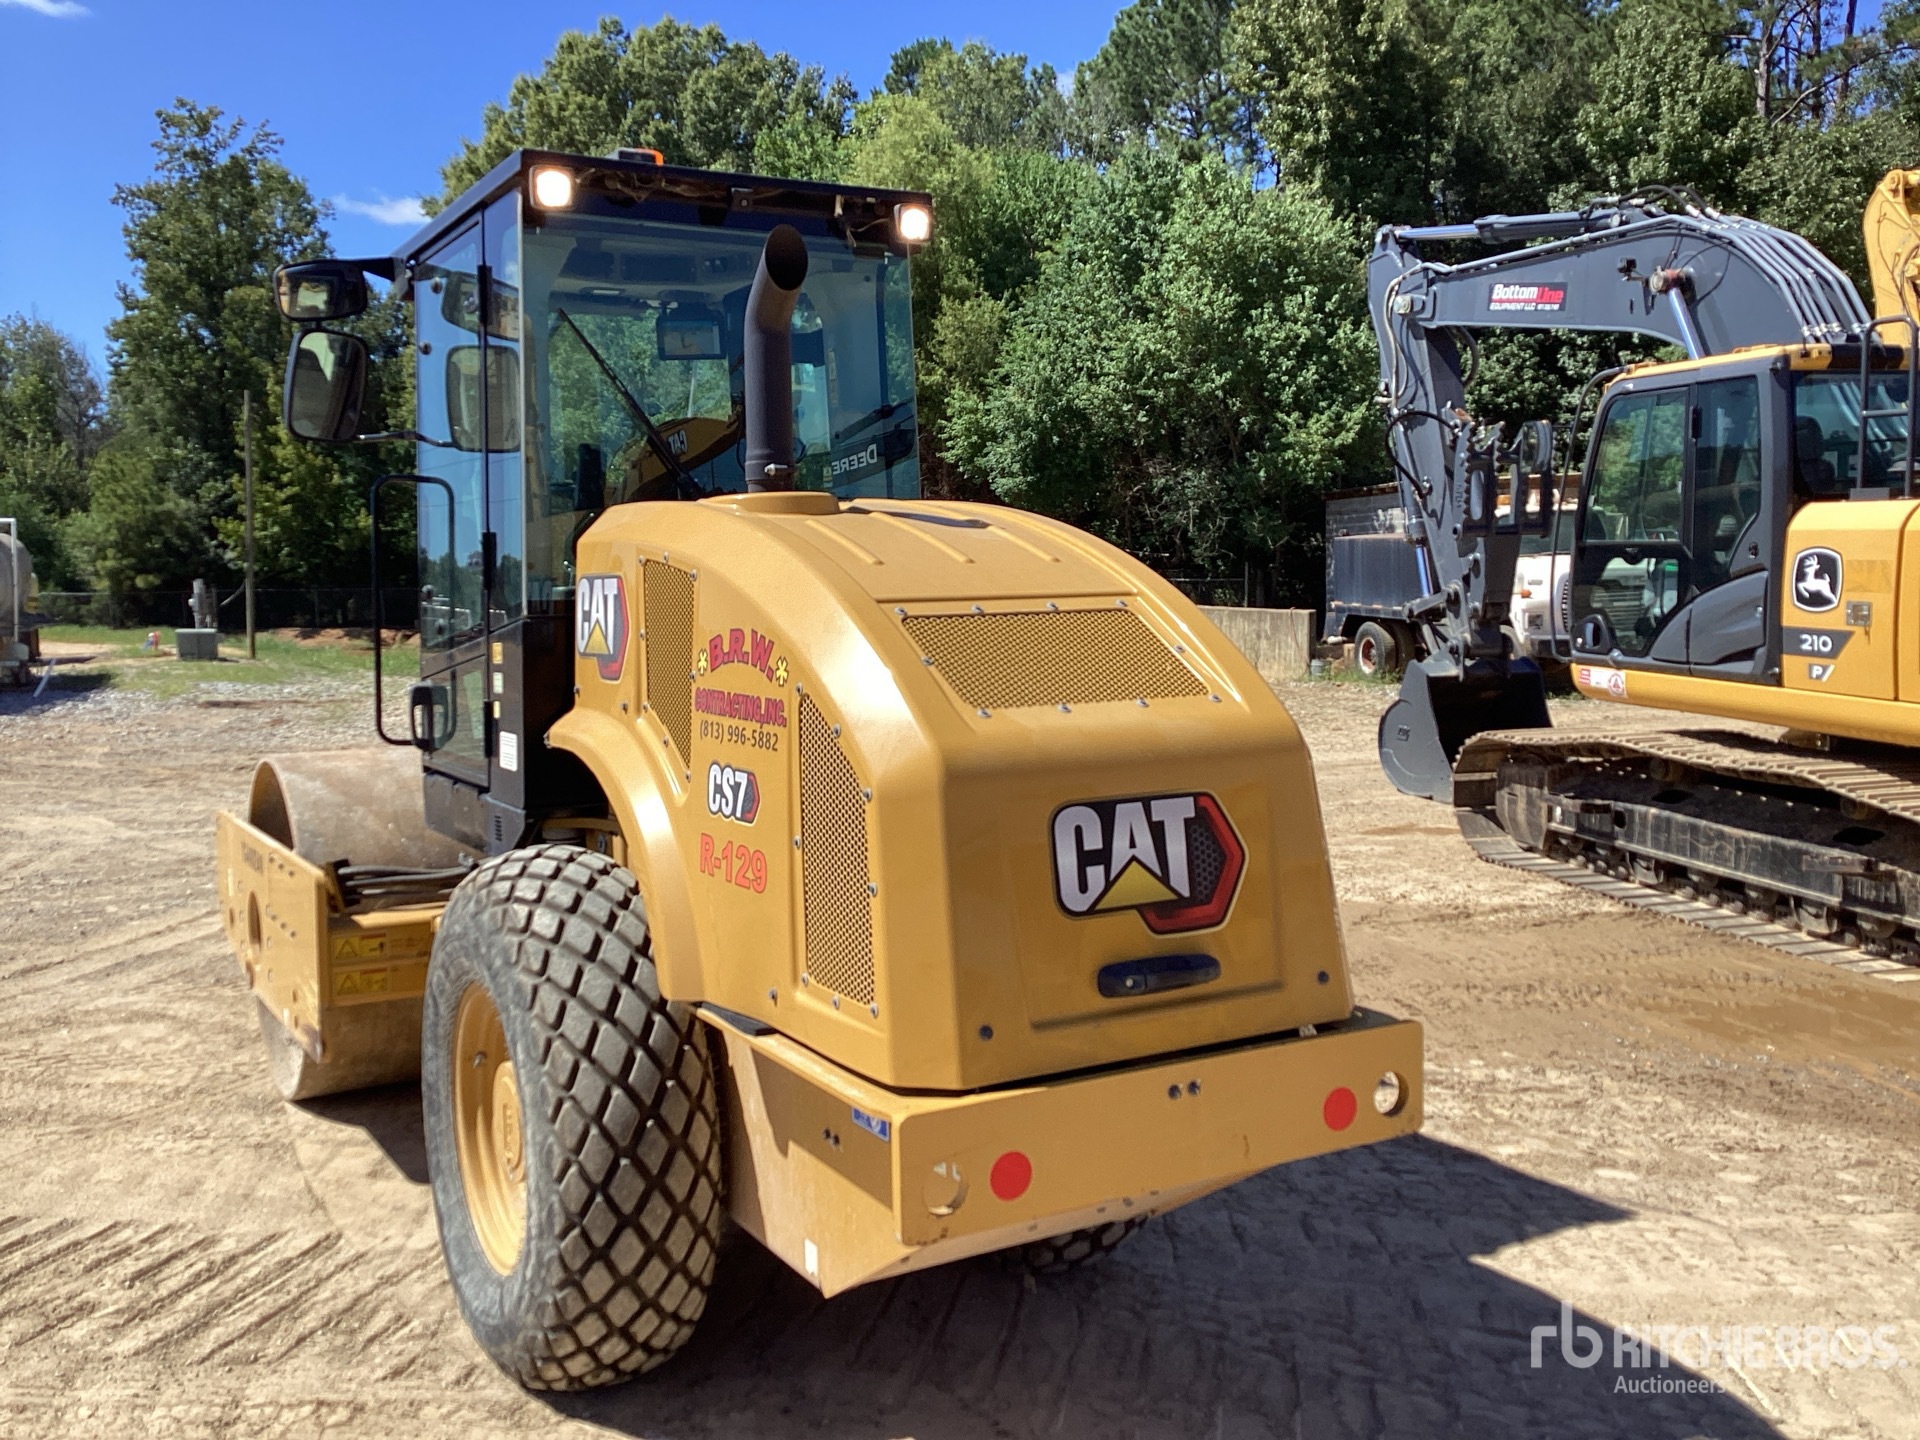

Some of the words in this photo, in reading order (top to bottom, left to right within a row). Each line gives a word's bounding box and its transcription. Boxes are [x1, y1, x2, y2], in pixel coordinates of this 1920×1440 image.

[1492, 284, 1538, 300] Bottom
[1536, 286, 1564, 303] Line
[576, 576, 618, 655] CAT
[1800, 633, 1833, 652] 210
[709, 628, 775, 683] B.R.W.
[700, 719, 725, 744] (813)
[727, 724, 779, 752] 996-5882
[708, 762, 748, 820] CS7
[700, 833, 767, 893] R-129
[1054, 796, 1196, 912] CAT
